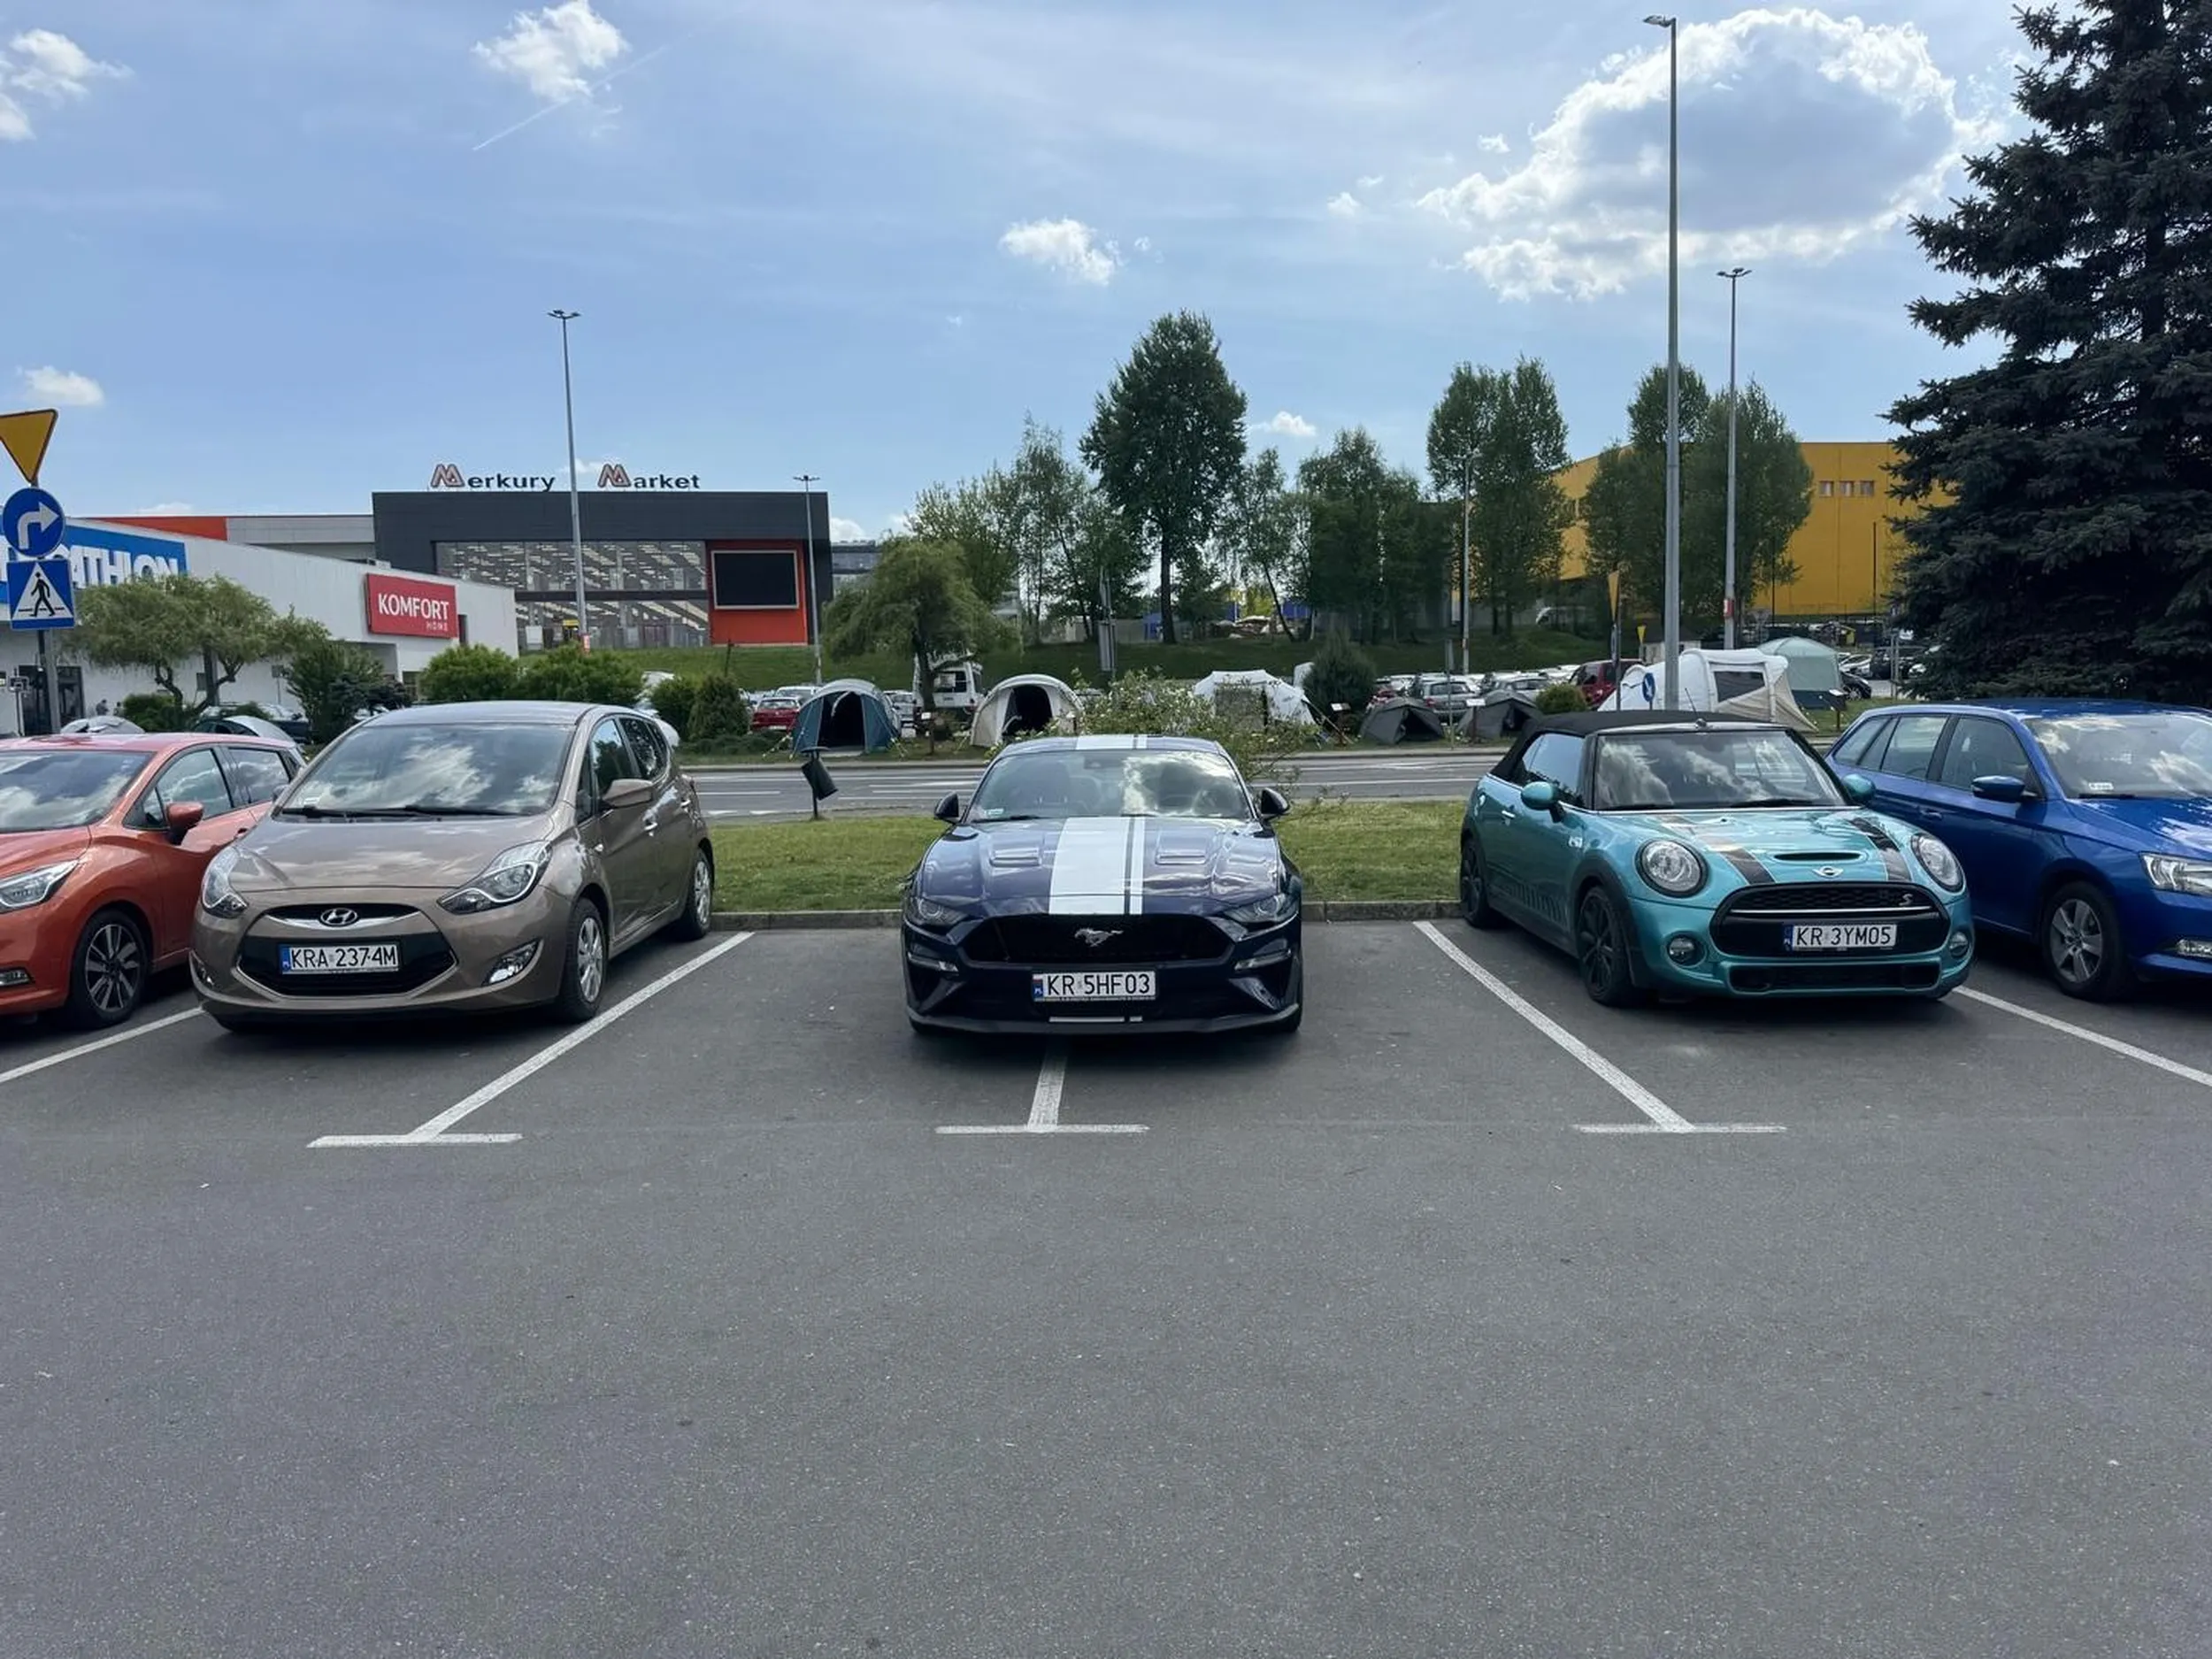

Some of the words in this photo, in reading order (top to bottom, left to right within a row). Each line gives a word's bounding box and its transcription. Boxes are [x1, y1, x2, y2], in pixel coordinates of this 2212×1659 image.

[431, 464, 556, 492] Merkury
[598, 464, 701, 488] Market
[378, 593, 449, 620] KOMFORT
[1796, 927, 1823, 946] KR
[1831, 926, 1892, 945] 3YM05
[291, 949, 329, 968] KRA
[334, 947, 396, 967] 2374M
[1048, 974, 1075, 995] KR
[1084, 974, 1150, 995] 5HF03
